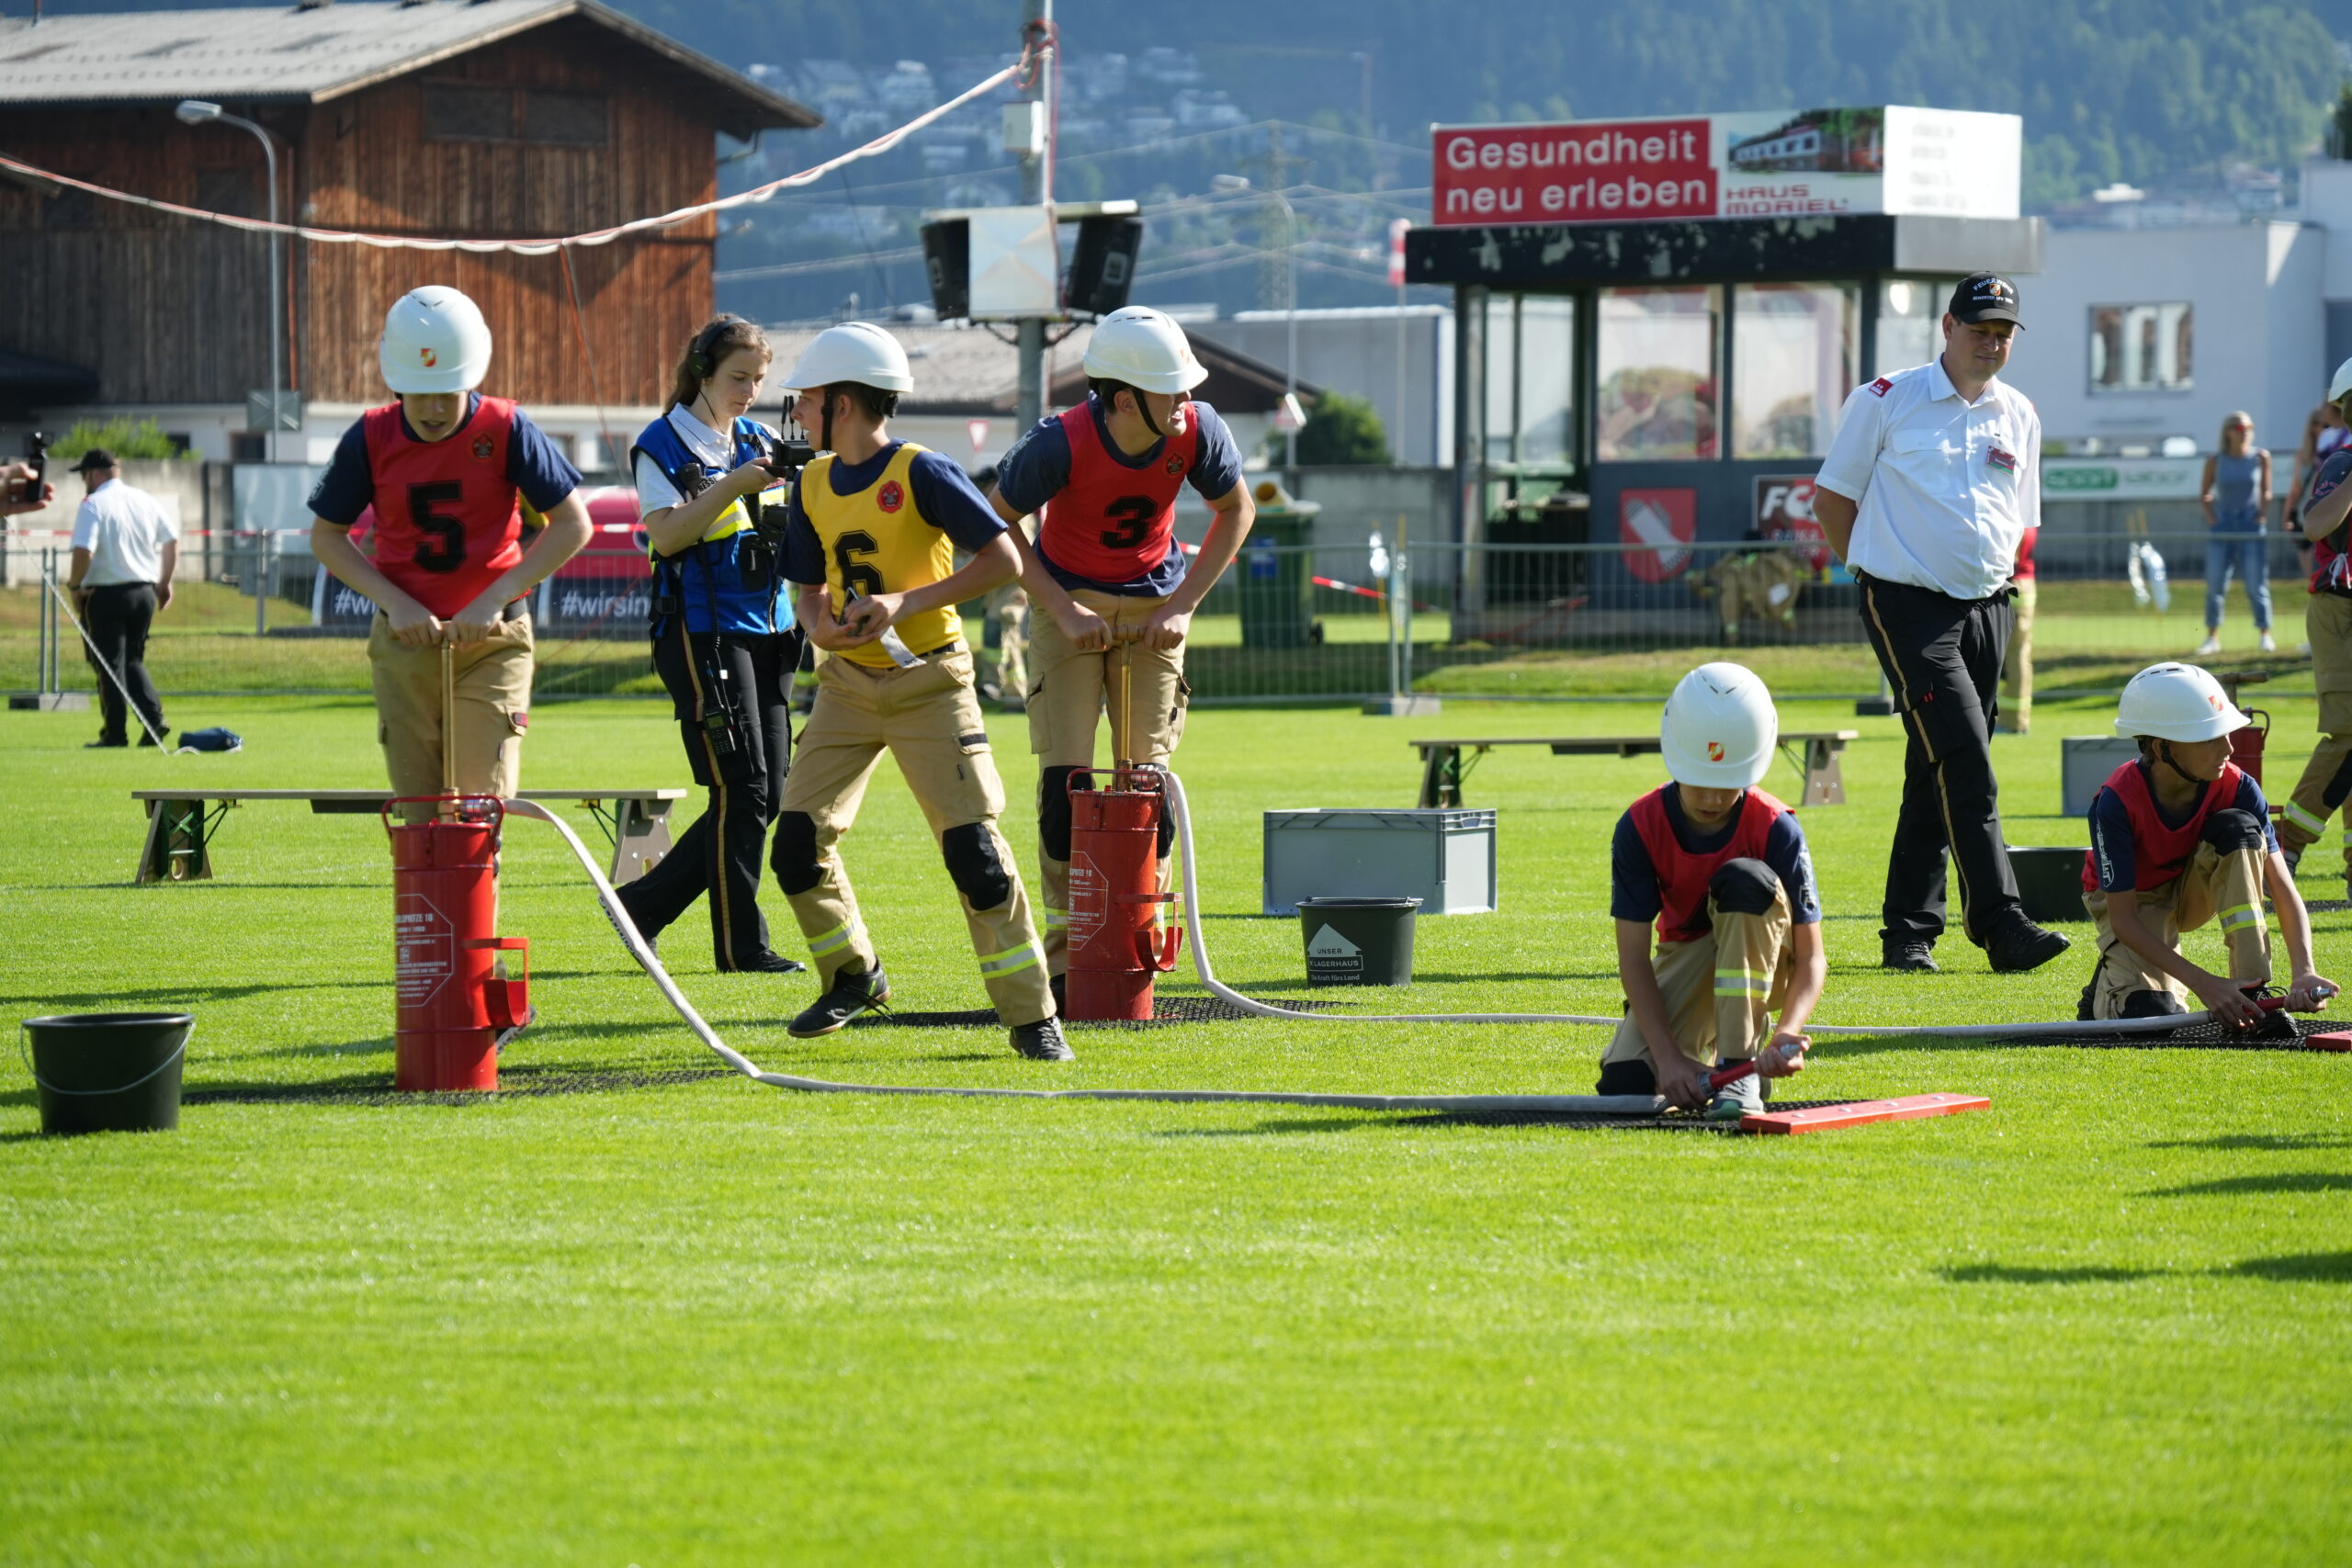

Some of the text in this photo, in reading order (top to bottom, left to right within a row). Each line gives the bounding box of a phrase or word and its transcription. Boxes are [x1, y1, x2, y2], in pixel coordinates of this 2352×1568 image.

[1445, 129, 1697, 170] Gesundheit
[1445, 175, 1707, 213] neu erleben
[1725, 184, 1809, 200] HAUS
[406, 479, 467, 574] 5
[1098, 495, 1158, 549] 3
[832, 529, 886, 597] 6
